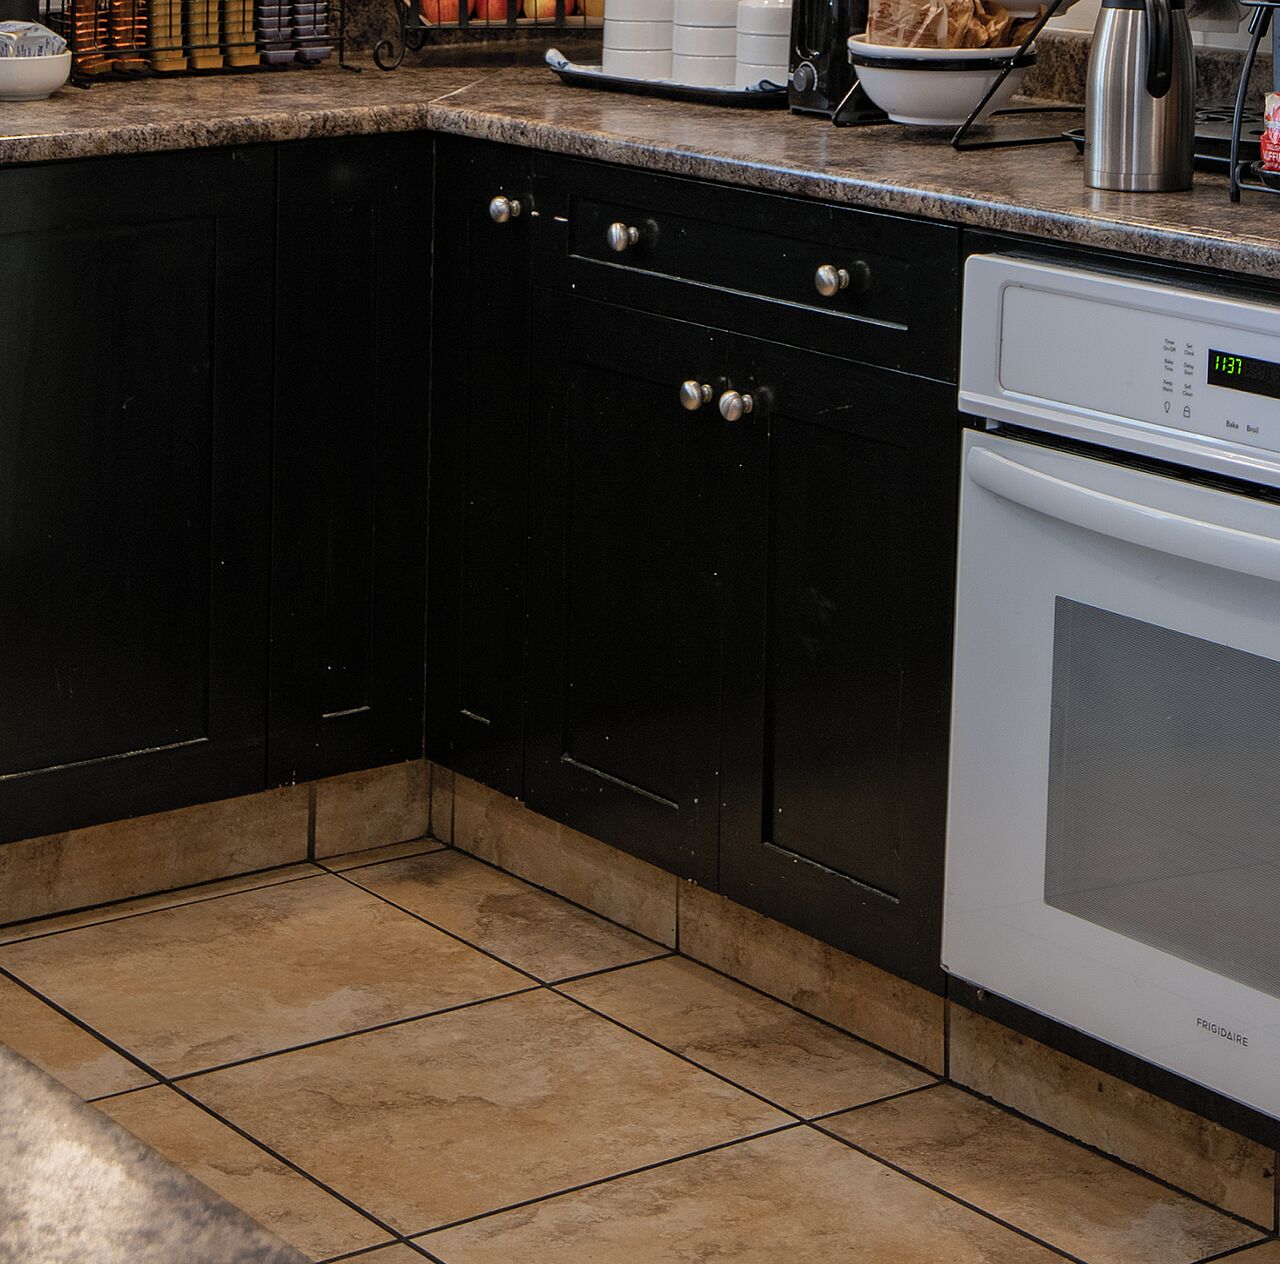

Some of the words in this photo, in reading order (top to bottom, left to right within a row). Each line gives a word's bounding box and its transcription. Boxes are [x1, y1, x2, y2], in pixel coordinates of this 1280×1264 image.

[1225, 420, 1239, 430] Bake
[1246, 424, 1259, 434] Broil
[1196, 1017, 1249, 1047] FRIGIDAIRE
